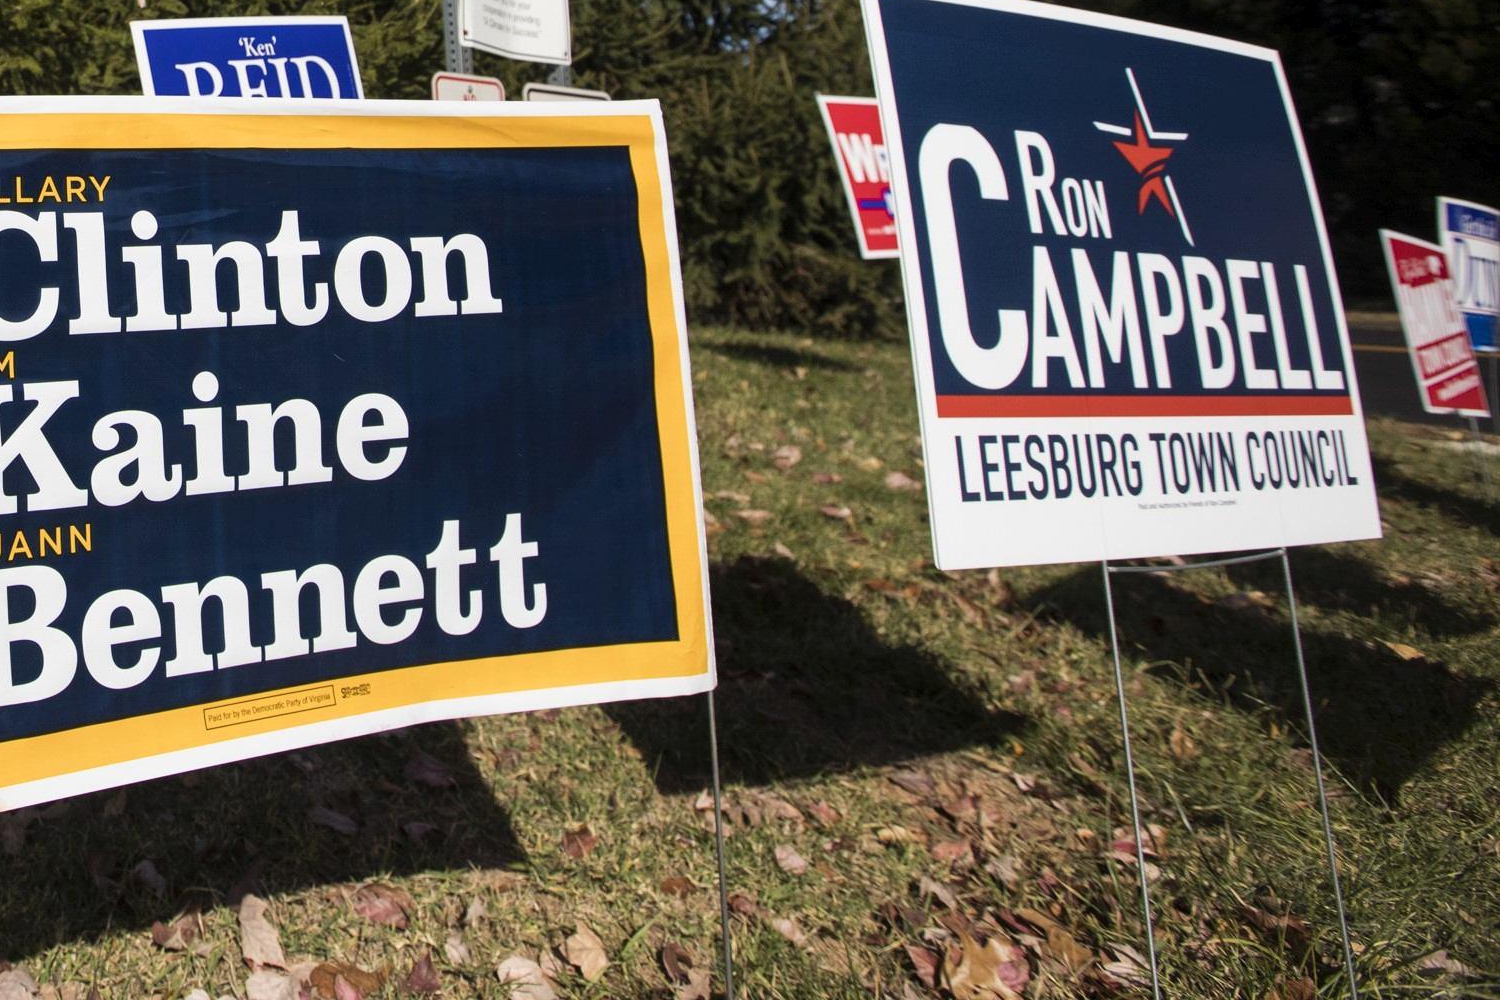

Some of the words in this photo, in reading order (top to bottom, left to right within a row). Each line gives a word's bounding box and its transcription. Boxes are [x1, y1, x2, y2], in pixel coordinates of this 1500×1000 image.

[918, 122, 1346, 390] CAMPBELL
[955, 433, 1143, 502] LEESBURG
[1149, 431, 1240, 495] TOWN
[1246, 430, 1358, 491] COUNCIL
[207, 711, 222, 723] Paid
[223, 710, 232, 720] for
[232, 710, 240, 719] by
[241, 707, 251, 716] the
[251, 700, 285, 714] Democratic
[286, 698, 301, 708] Party
[302, 696, 309, 705] of
[309, 692, 331, 705] Virginia
